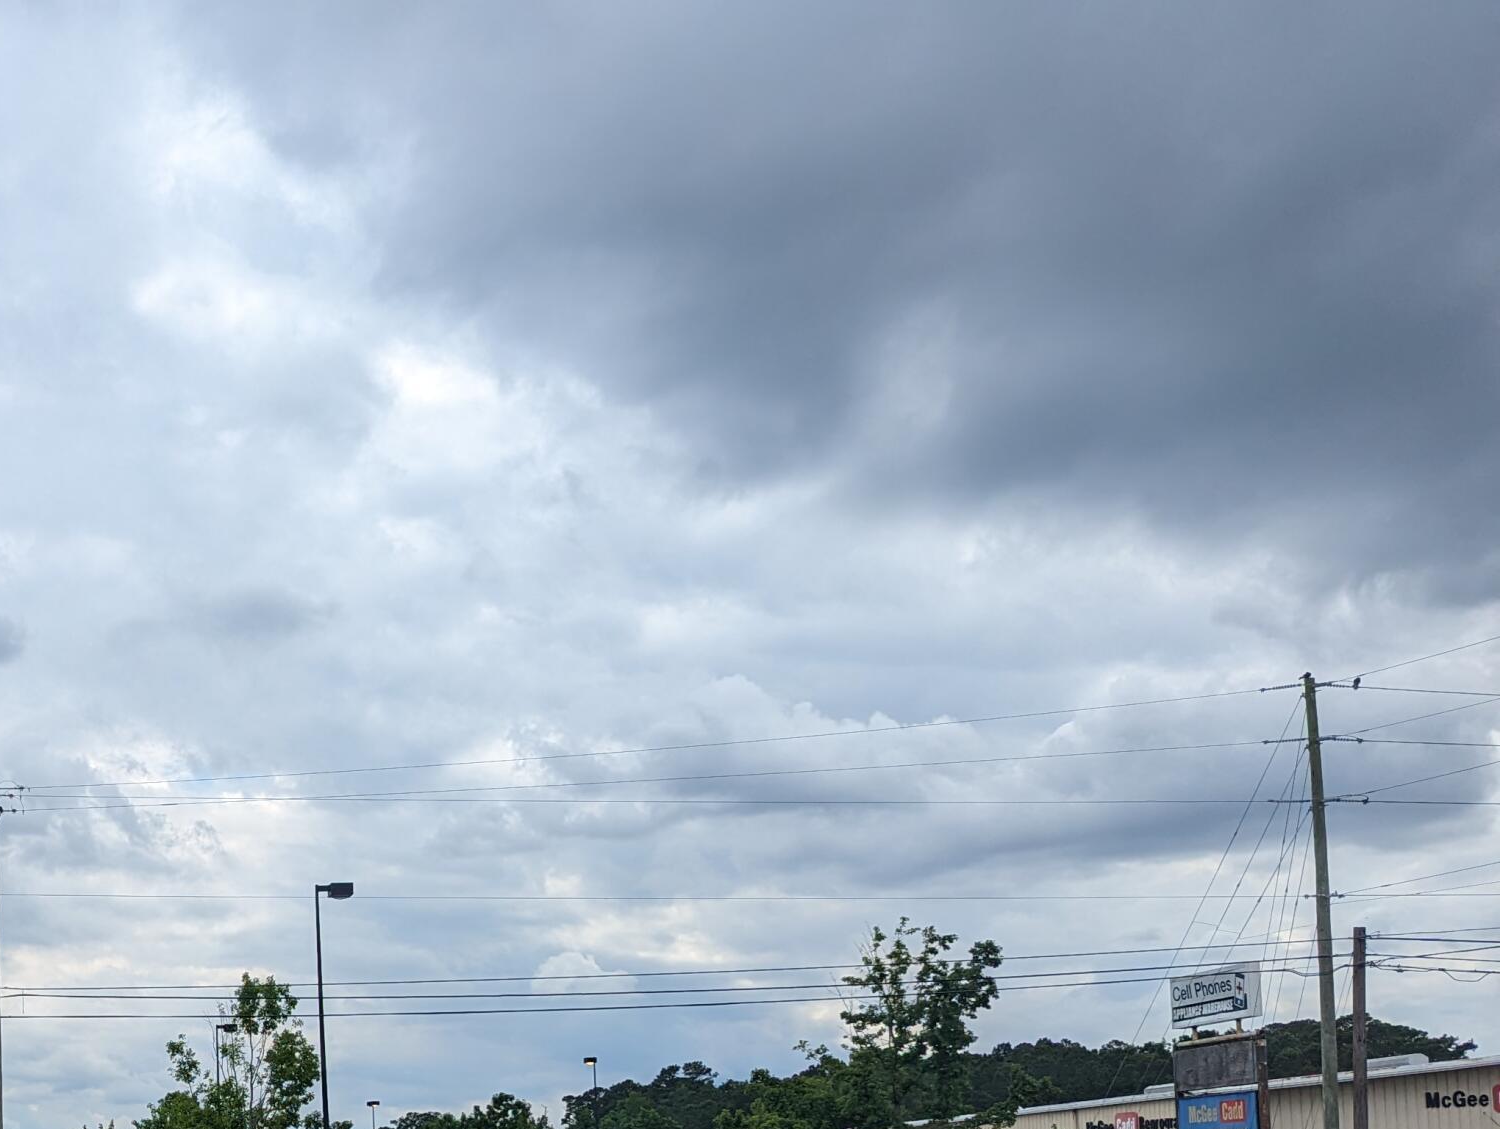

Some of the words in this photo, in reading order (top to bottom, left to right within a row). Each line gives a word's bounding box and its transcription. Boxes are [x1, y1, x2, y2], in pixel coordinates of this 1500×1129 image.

[1172, 984, 1193, 1002] Cell
[1194, 979, 1232, 998] Phones
[1425, 1090, 1489, 1109] McGee
[1188, 1104, 1218, 1124] McGee
[1221, 1101, 1244, 1121] Cadd
